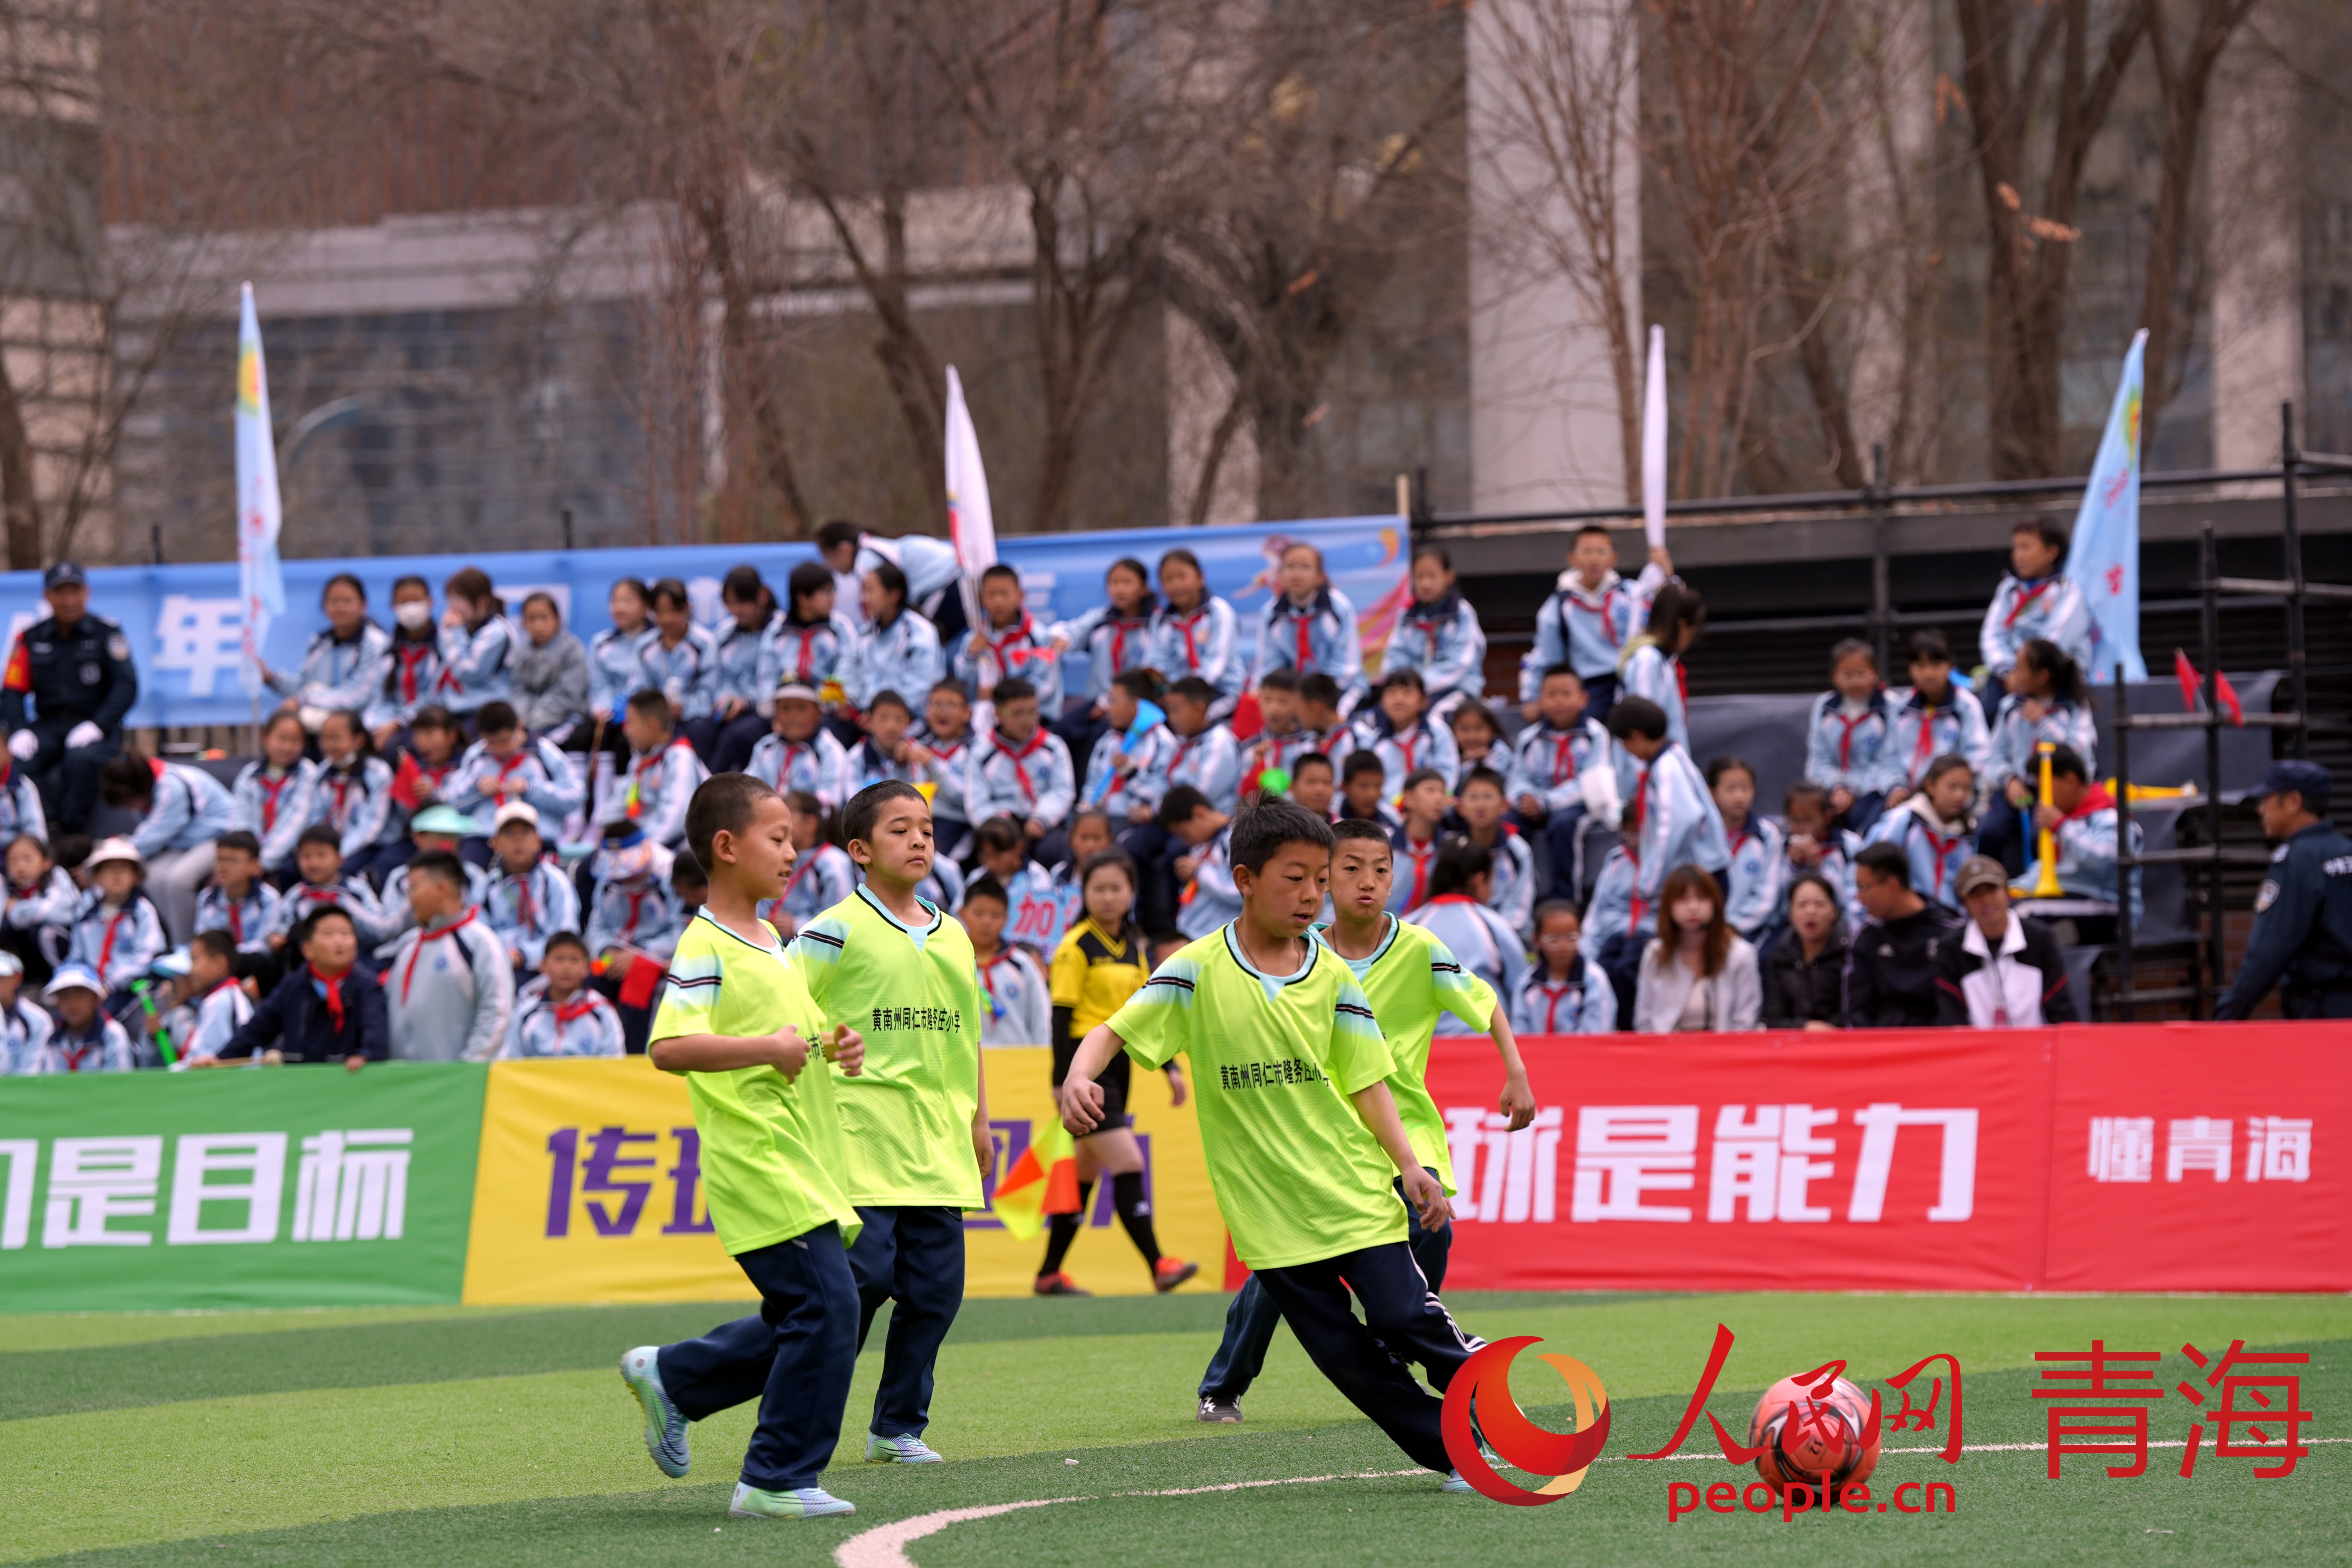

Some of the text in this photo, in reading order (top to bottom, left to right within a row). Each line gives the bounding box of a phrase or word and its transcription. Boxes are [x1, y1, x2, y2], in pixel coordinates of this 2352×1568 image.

[872, 1006, 961, 1034] 黄南州同仁市隆务庄小学
[2087, 1116, 2313, 1182] 懂青海
